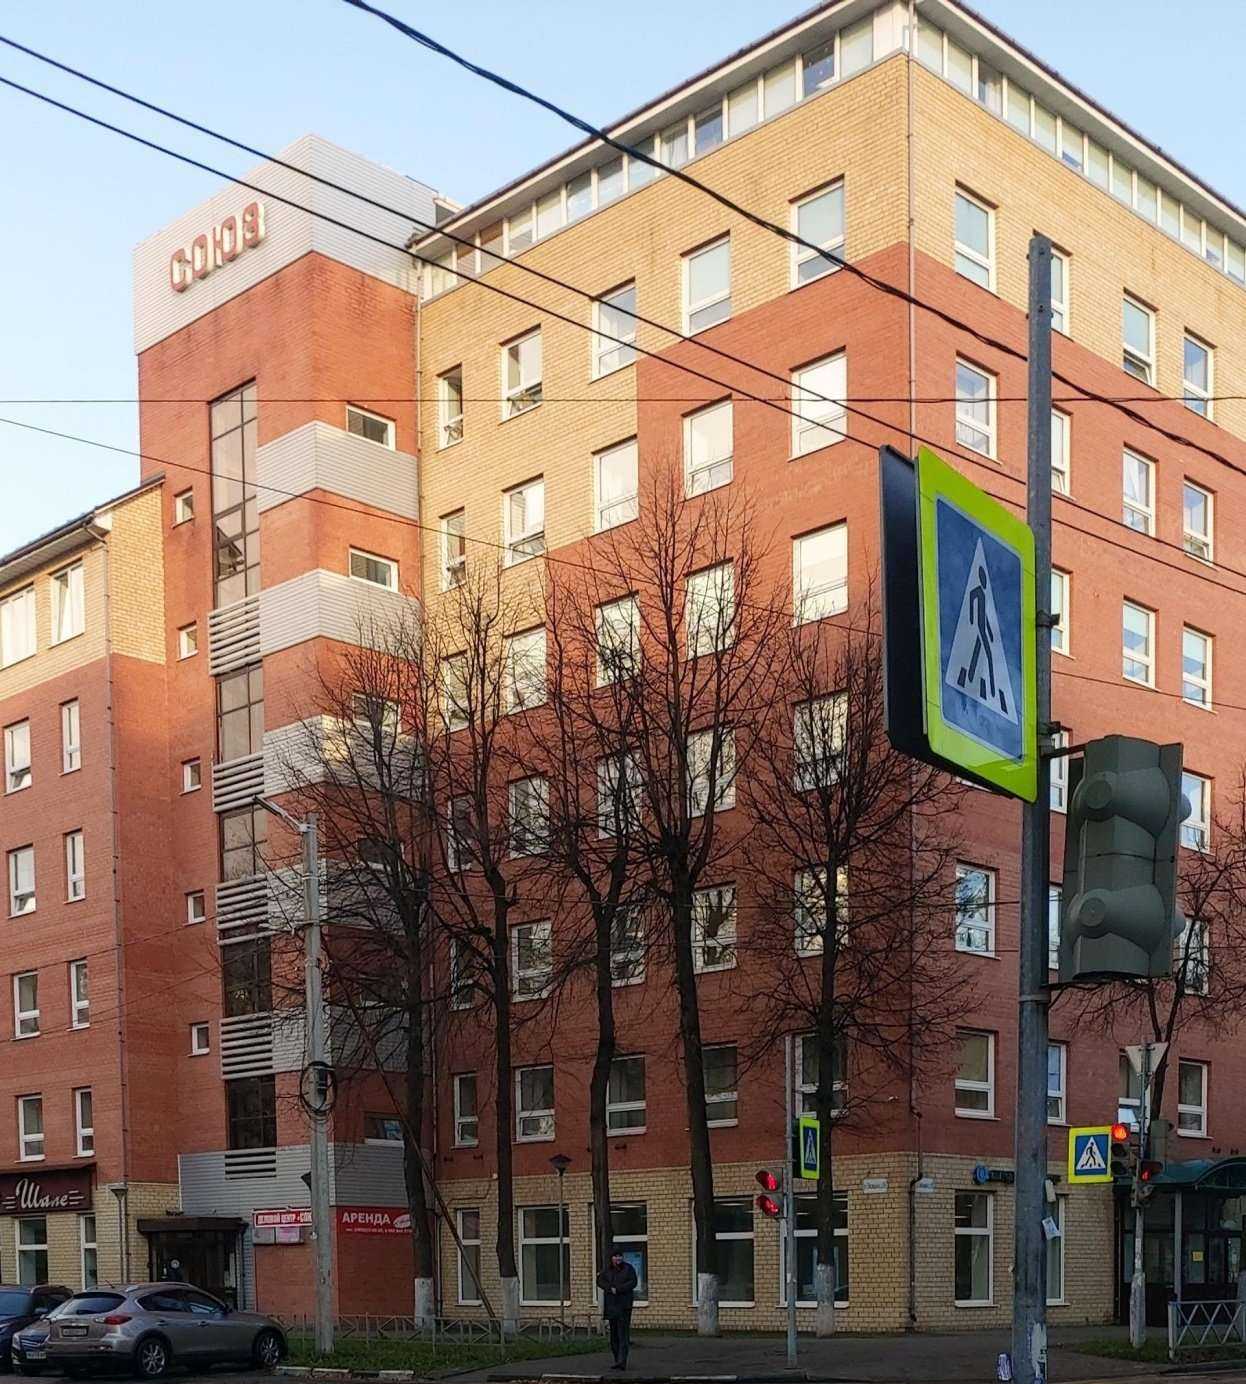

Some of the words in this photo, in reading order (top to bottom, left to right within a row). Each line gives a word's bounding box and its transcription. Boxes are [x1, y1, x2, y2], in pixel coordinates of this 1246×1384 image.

[170, 202, 264, 293] СОЮЗ
[16, 1178, 69, 1209] Шале
[342, 1212, 391, 1226] АРЕНДА
